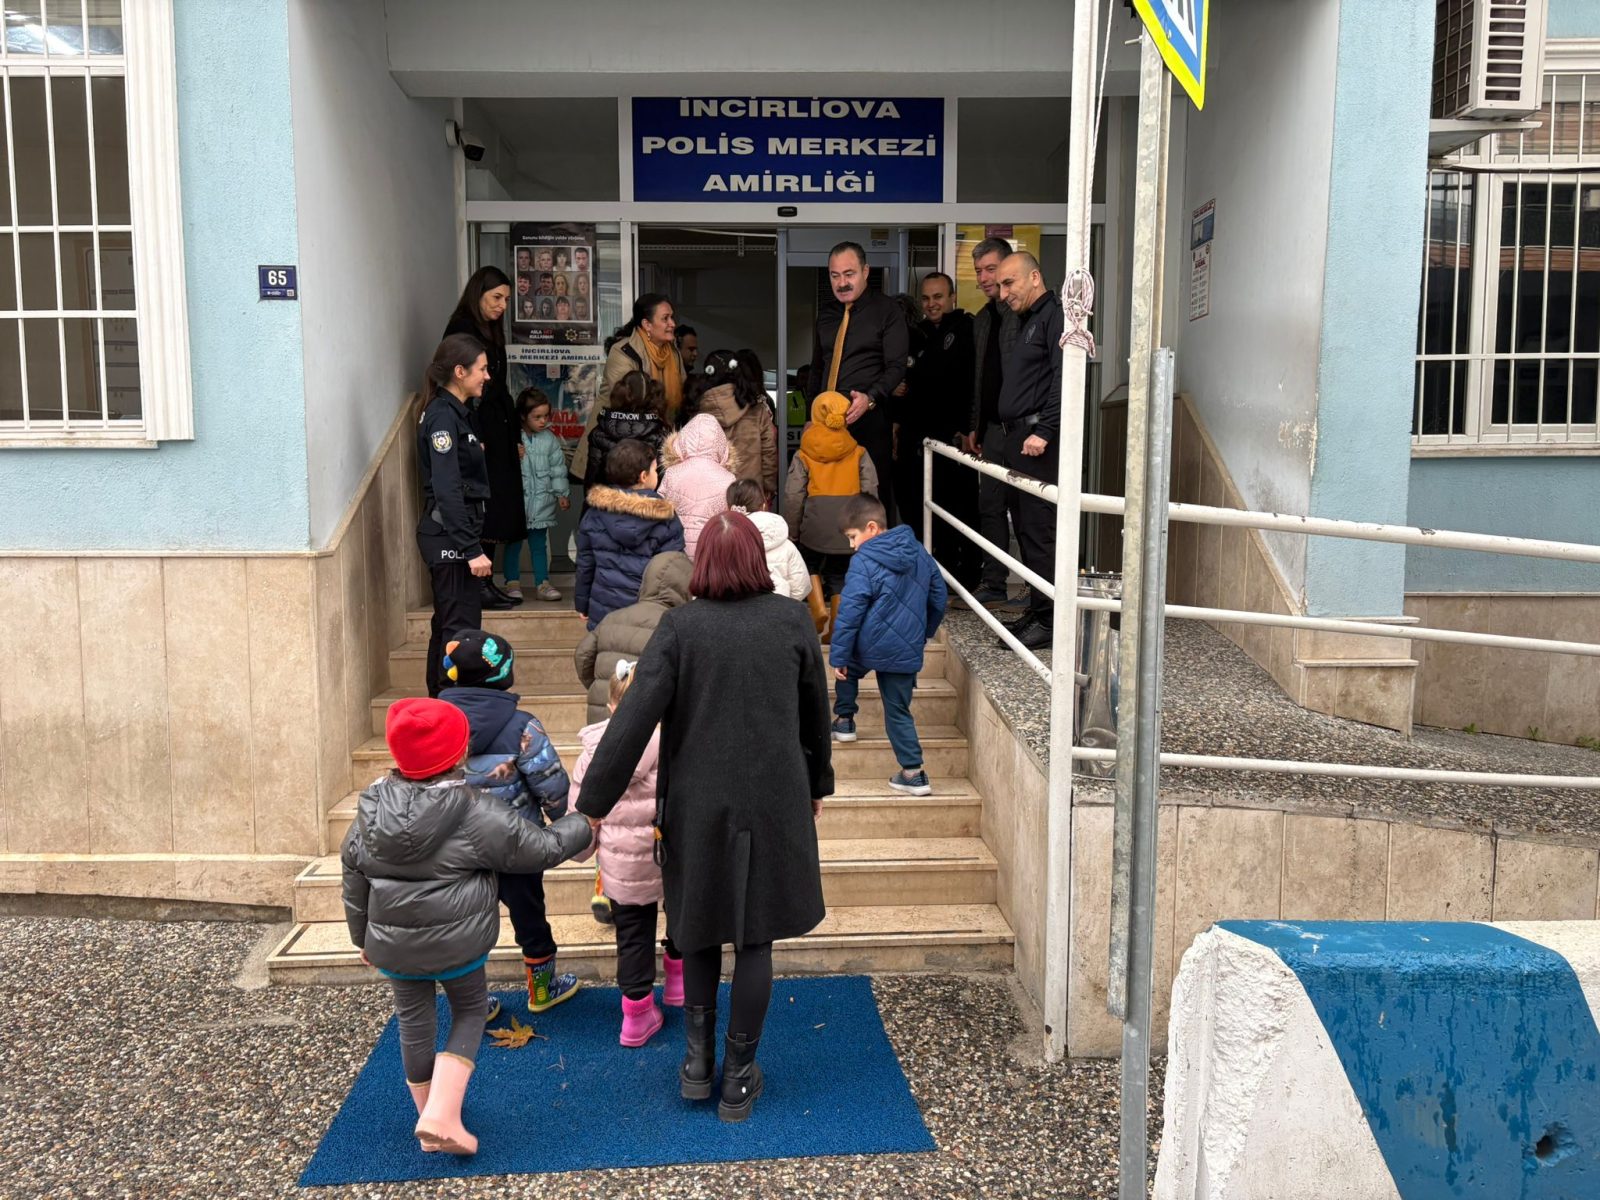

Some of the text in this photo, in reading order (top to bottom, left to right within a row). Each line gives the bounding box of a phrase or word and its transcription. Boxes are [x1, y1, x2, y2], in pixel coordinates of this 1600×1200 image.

[679, 97, 901, 119] İNCİRLİOVA
[642, 132, 936, 157] POLİS MERKEZİ
[702, 169, 875, 193] AMİRLİĞİ
[268, 270, 287, 286] 65
